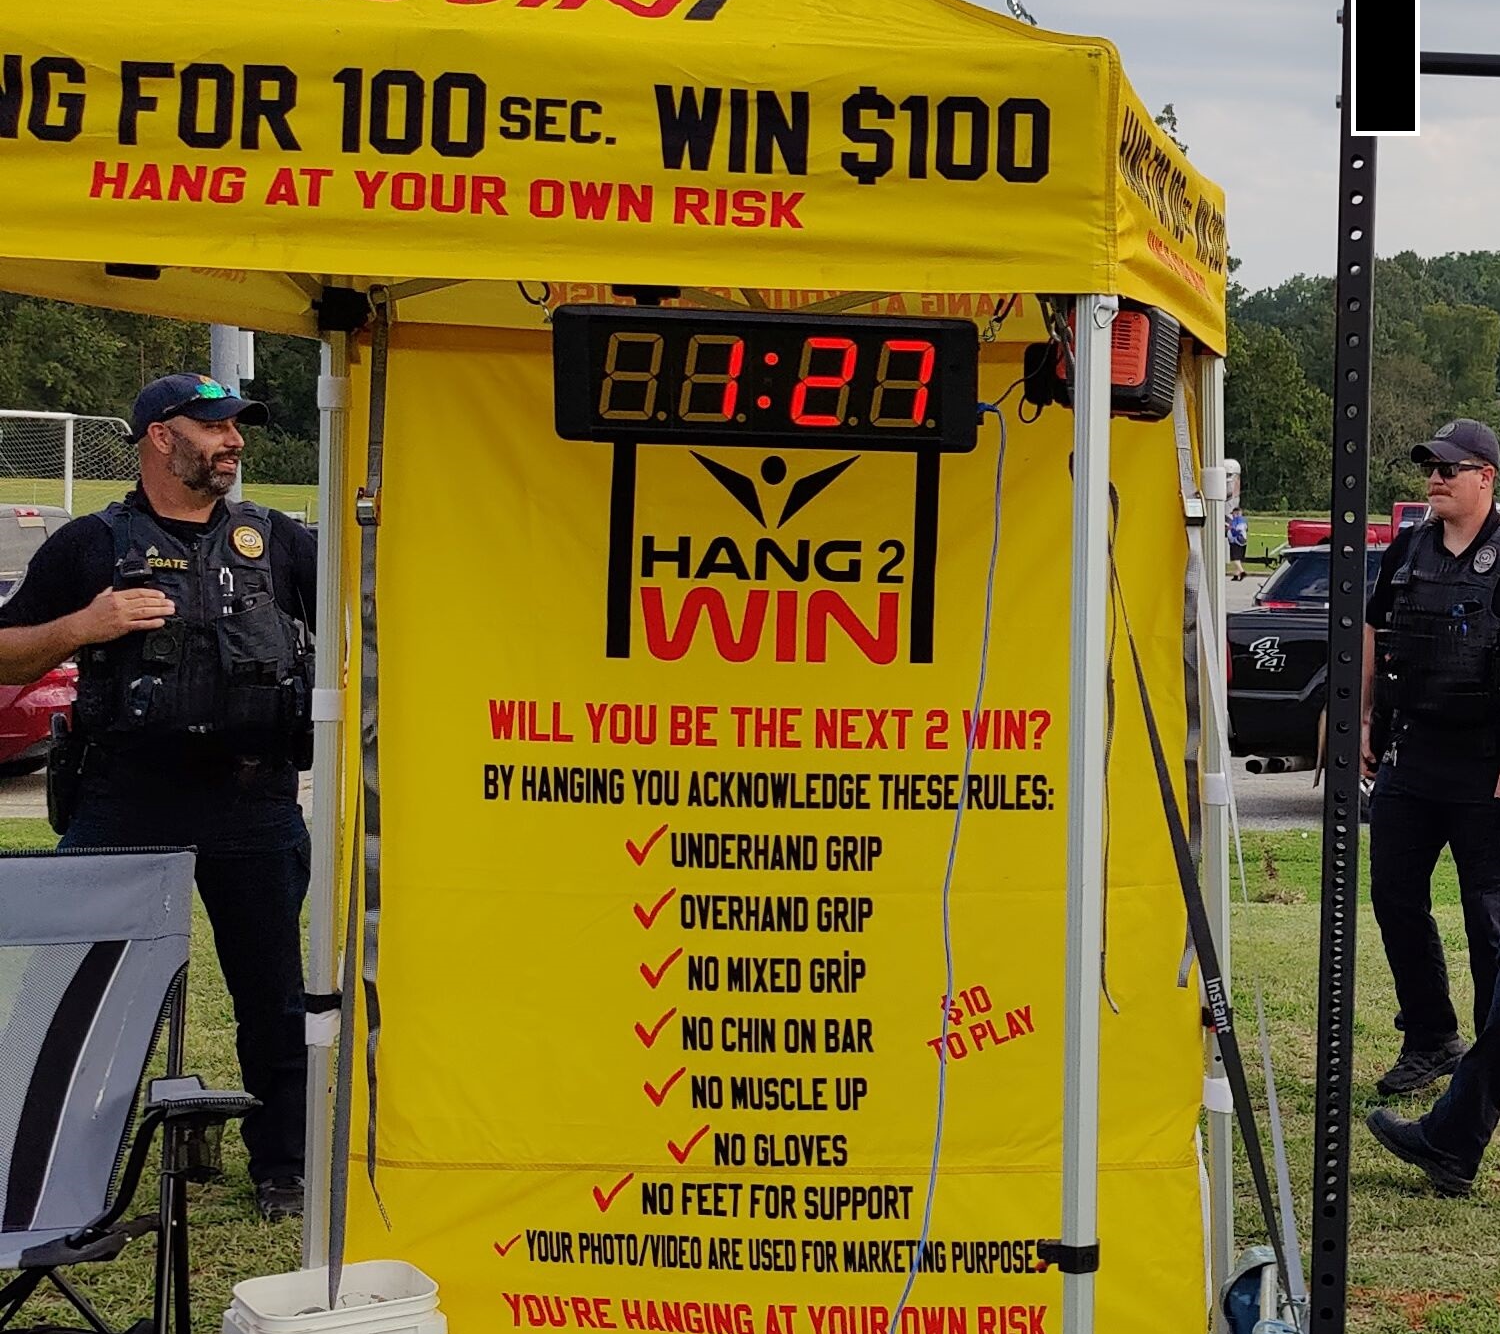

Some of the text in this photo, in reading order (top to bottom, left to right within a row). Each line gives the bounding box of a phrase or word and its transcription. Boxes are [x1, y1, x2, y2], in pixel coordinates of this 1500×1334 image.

[118, 61, 301, 151] FOR
[333, 68, 486, 157] 100
[500, 97, 616, 144] SEC.
[654, 85, 809, 175] WIN
[841, 86, 1050, 185] $100
[90, 161, 804, 228] HANG AT YOUR OWN RISK
[641, 536, 905, 583] HANG 2
[640, 586, 899, 665] WIN
[489, 700, 1051, 750] WILL YOU BE THE NEXT 2 WIN?
[485, 765, 1053, 810] BY HANGING YOU ACKNOWLEDGE THESE RULES:
[671, 833, 882, 871] UNDERHAND GRIP
[681, 895, 872, 932] OVERHAND GRIP
[689, 956, 718, 991] NO
[728, 957, 800, 992] MIXED
[940, 985, 993, 1026] $10
[683, 1017, 873, 1053] NO CHIN ON BAR
[927, 1005, 1034, 1065] TO PLAY
[692, 1076, 867, 1110] NO MUSCLE UP
[715, 1133, 847, 1166] NO GLOVES
[643, 1183, 913, 1220] NO FEET FOR SUPPORT
[527, 1230, 1048, 1273] YOUR PHOTO/VIDEO ARE USED FOR MARKETING PURPOSE
[503, 1293, 616, 1329] YOU'RE
